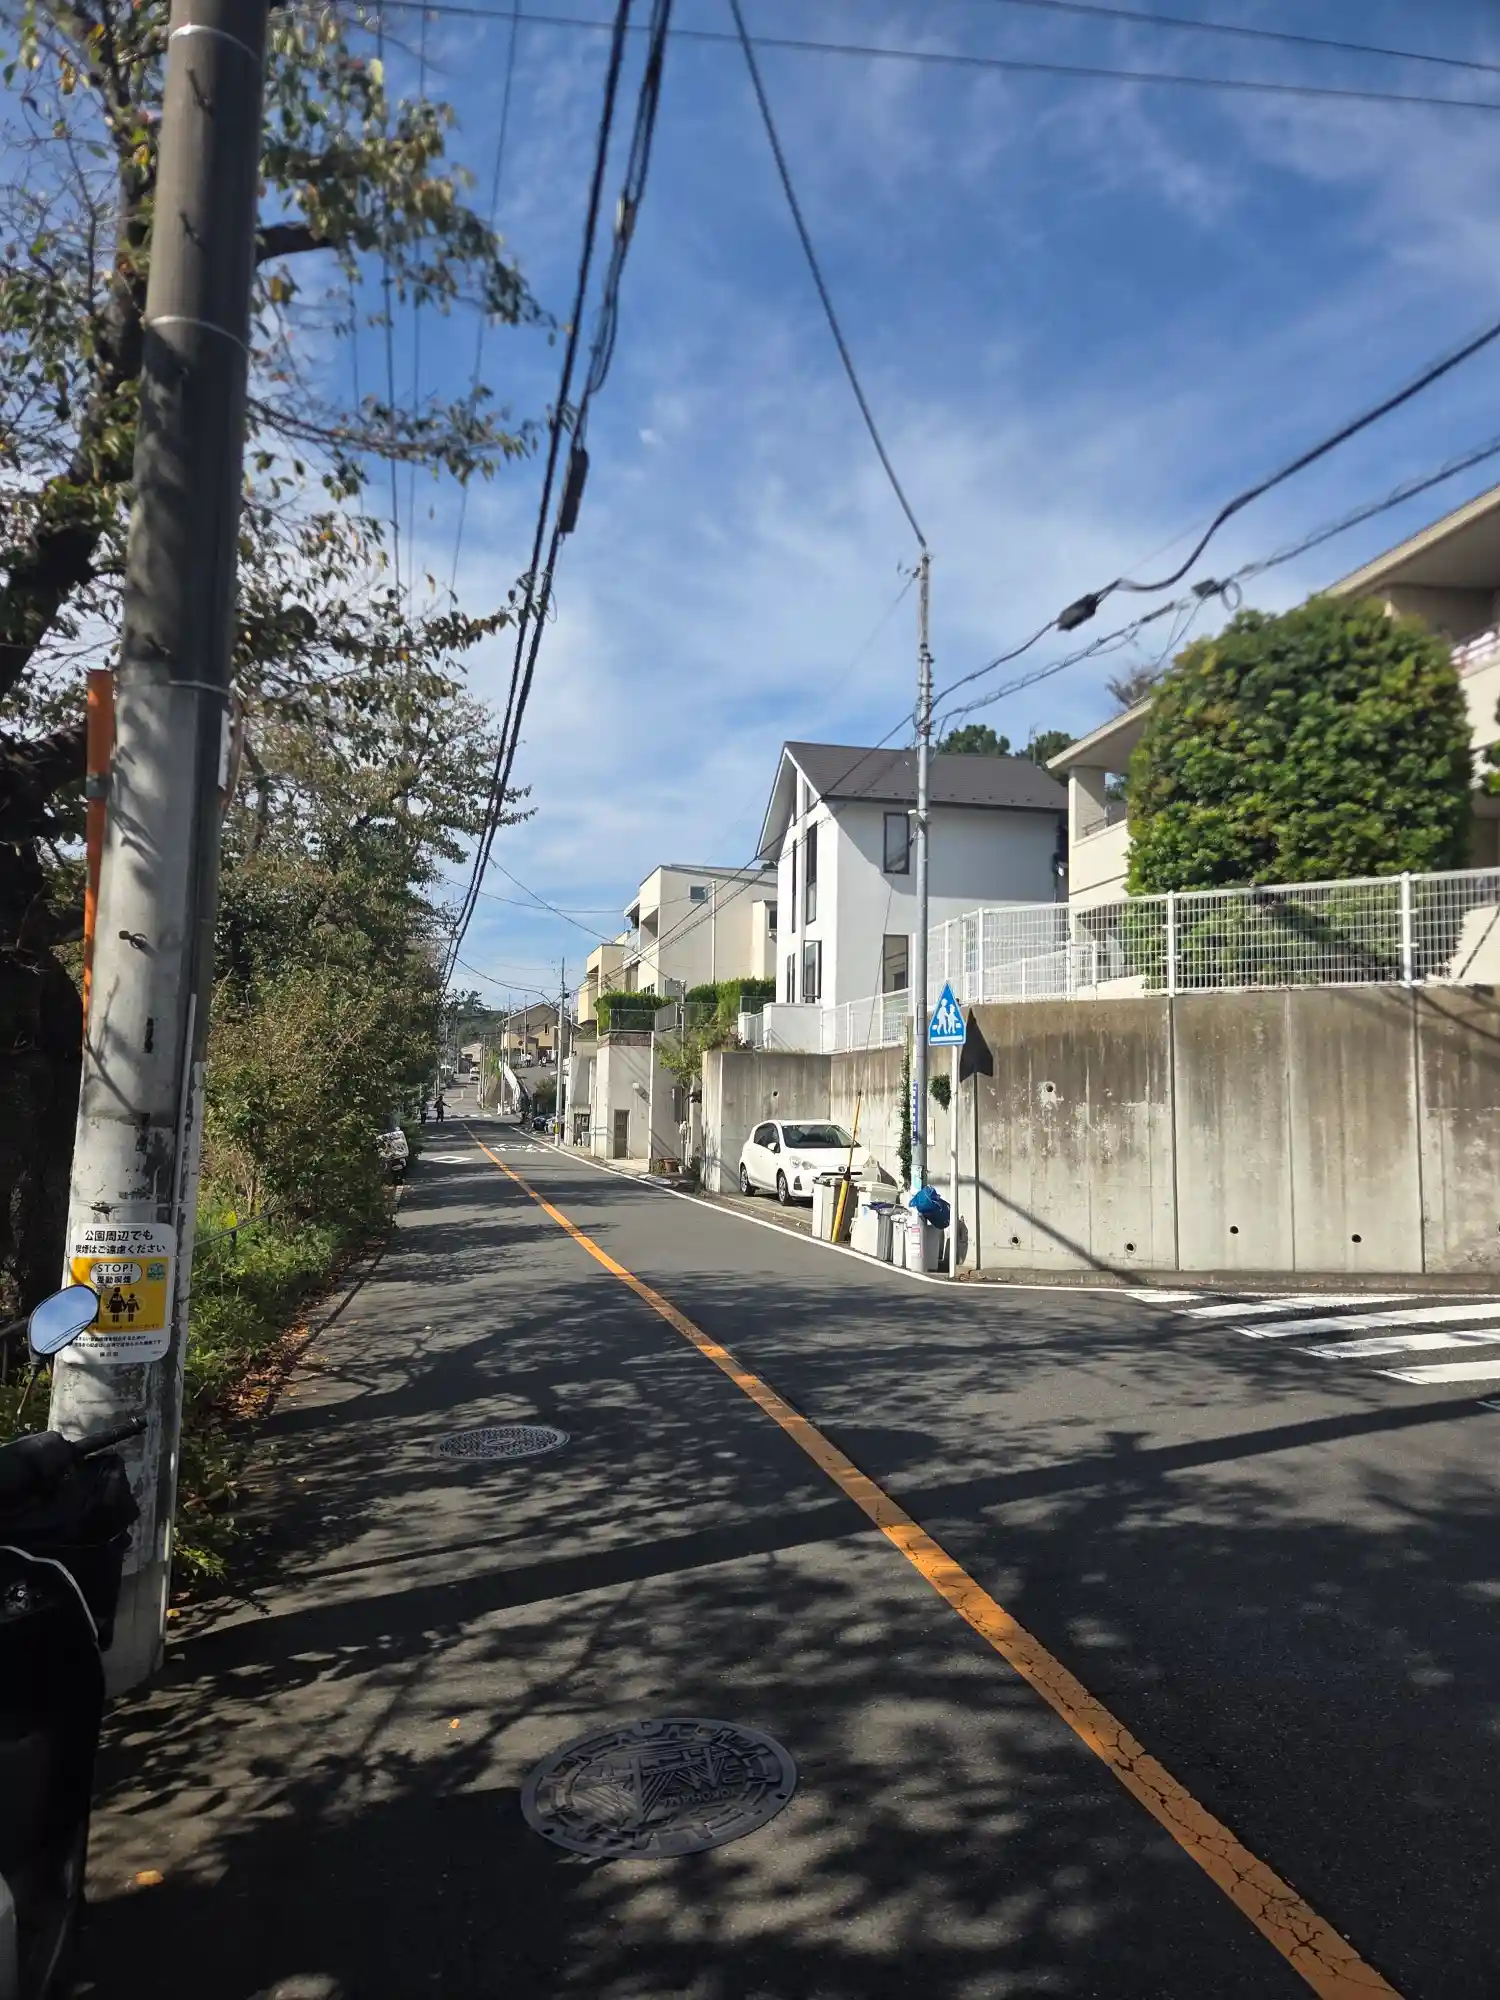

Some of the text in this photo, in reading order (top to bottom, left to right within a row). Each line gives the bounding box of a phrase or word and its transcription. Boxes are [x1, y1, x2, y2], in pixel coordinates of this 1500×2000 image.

[85, 1230, 153, 1241] 公園周辺でも
[75, 1244, 166, 1254] 喫煙はご遠慮ください
[97, 1264, 133, 1272] STOP!
